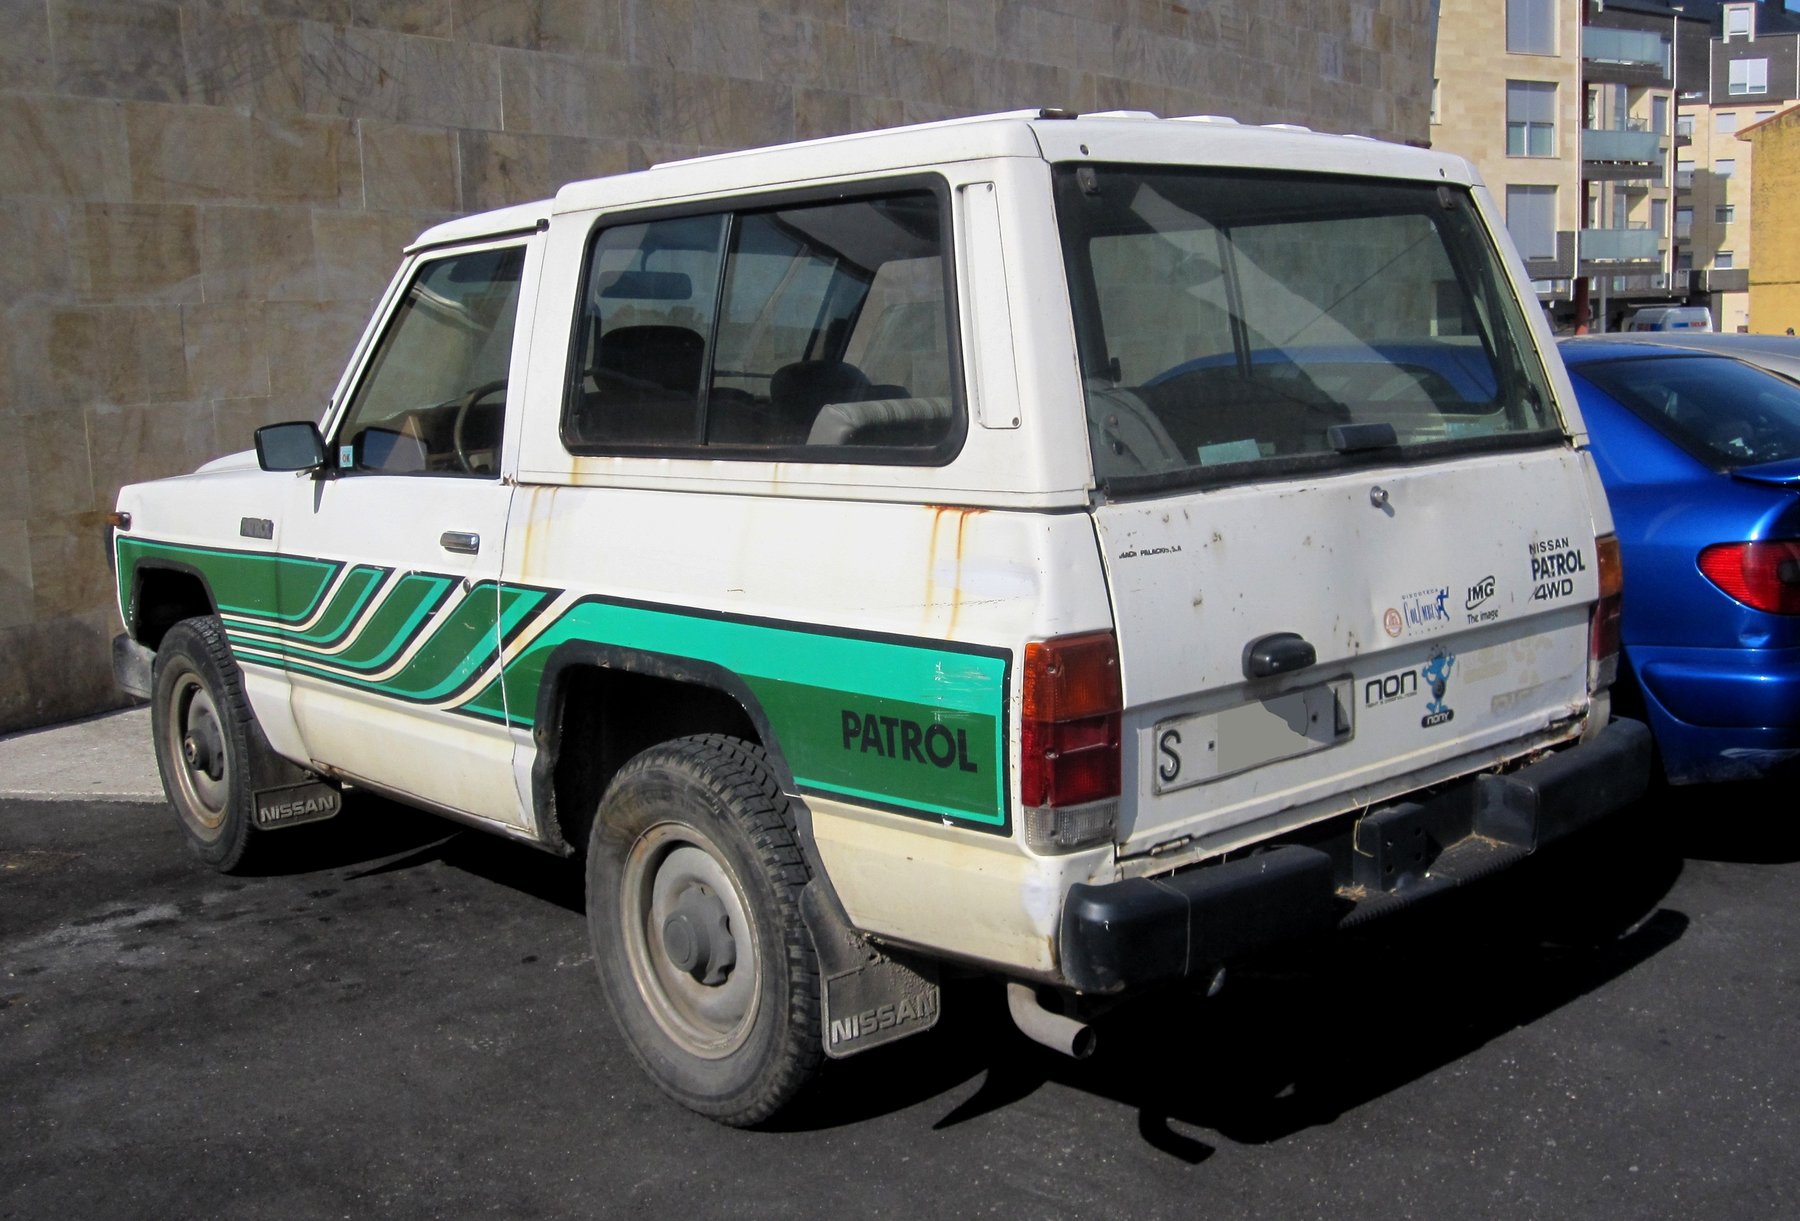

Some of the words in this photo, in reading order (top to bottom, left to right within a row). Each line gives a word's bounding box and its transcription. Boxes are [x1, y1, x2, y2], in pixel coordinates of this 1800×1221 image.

[1528, 537, 1569, 555] NISSAN
[1531, 549, 1586, 582] PATROL
[1466, 582, 1495, 602] IMG
[1534, 578, 1574, 601] 4WD
[1467, 613, 1480, 625] The
[1480, 608, 1499, 621] image
[841, 709, 978, 774] PATROL
[1160, 729, 1182, 782] S
[260, 795, 335, 822] NISSAN
[831, 988, 937, 1044] NISSAN
